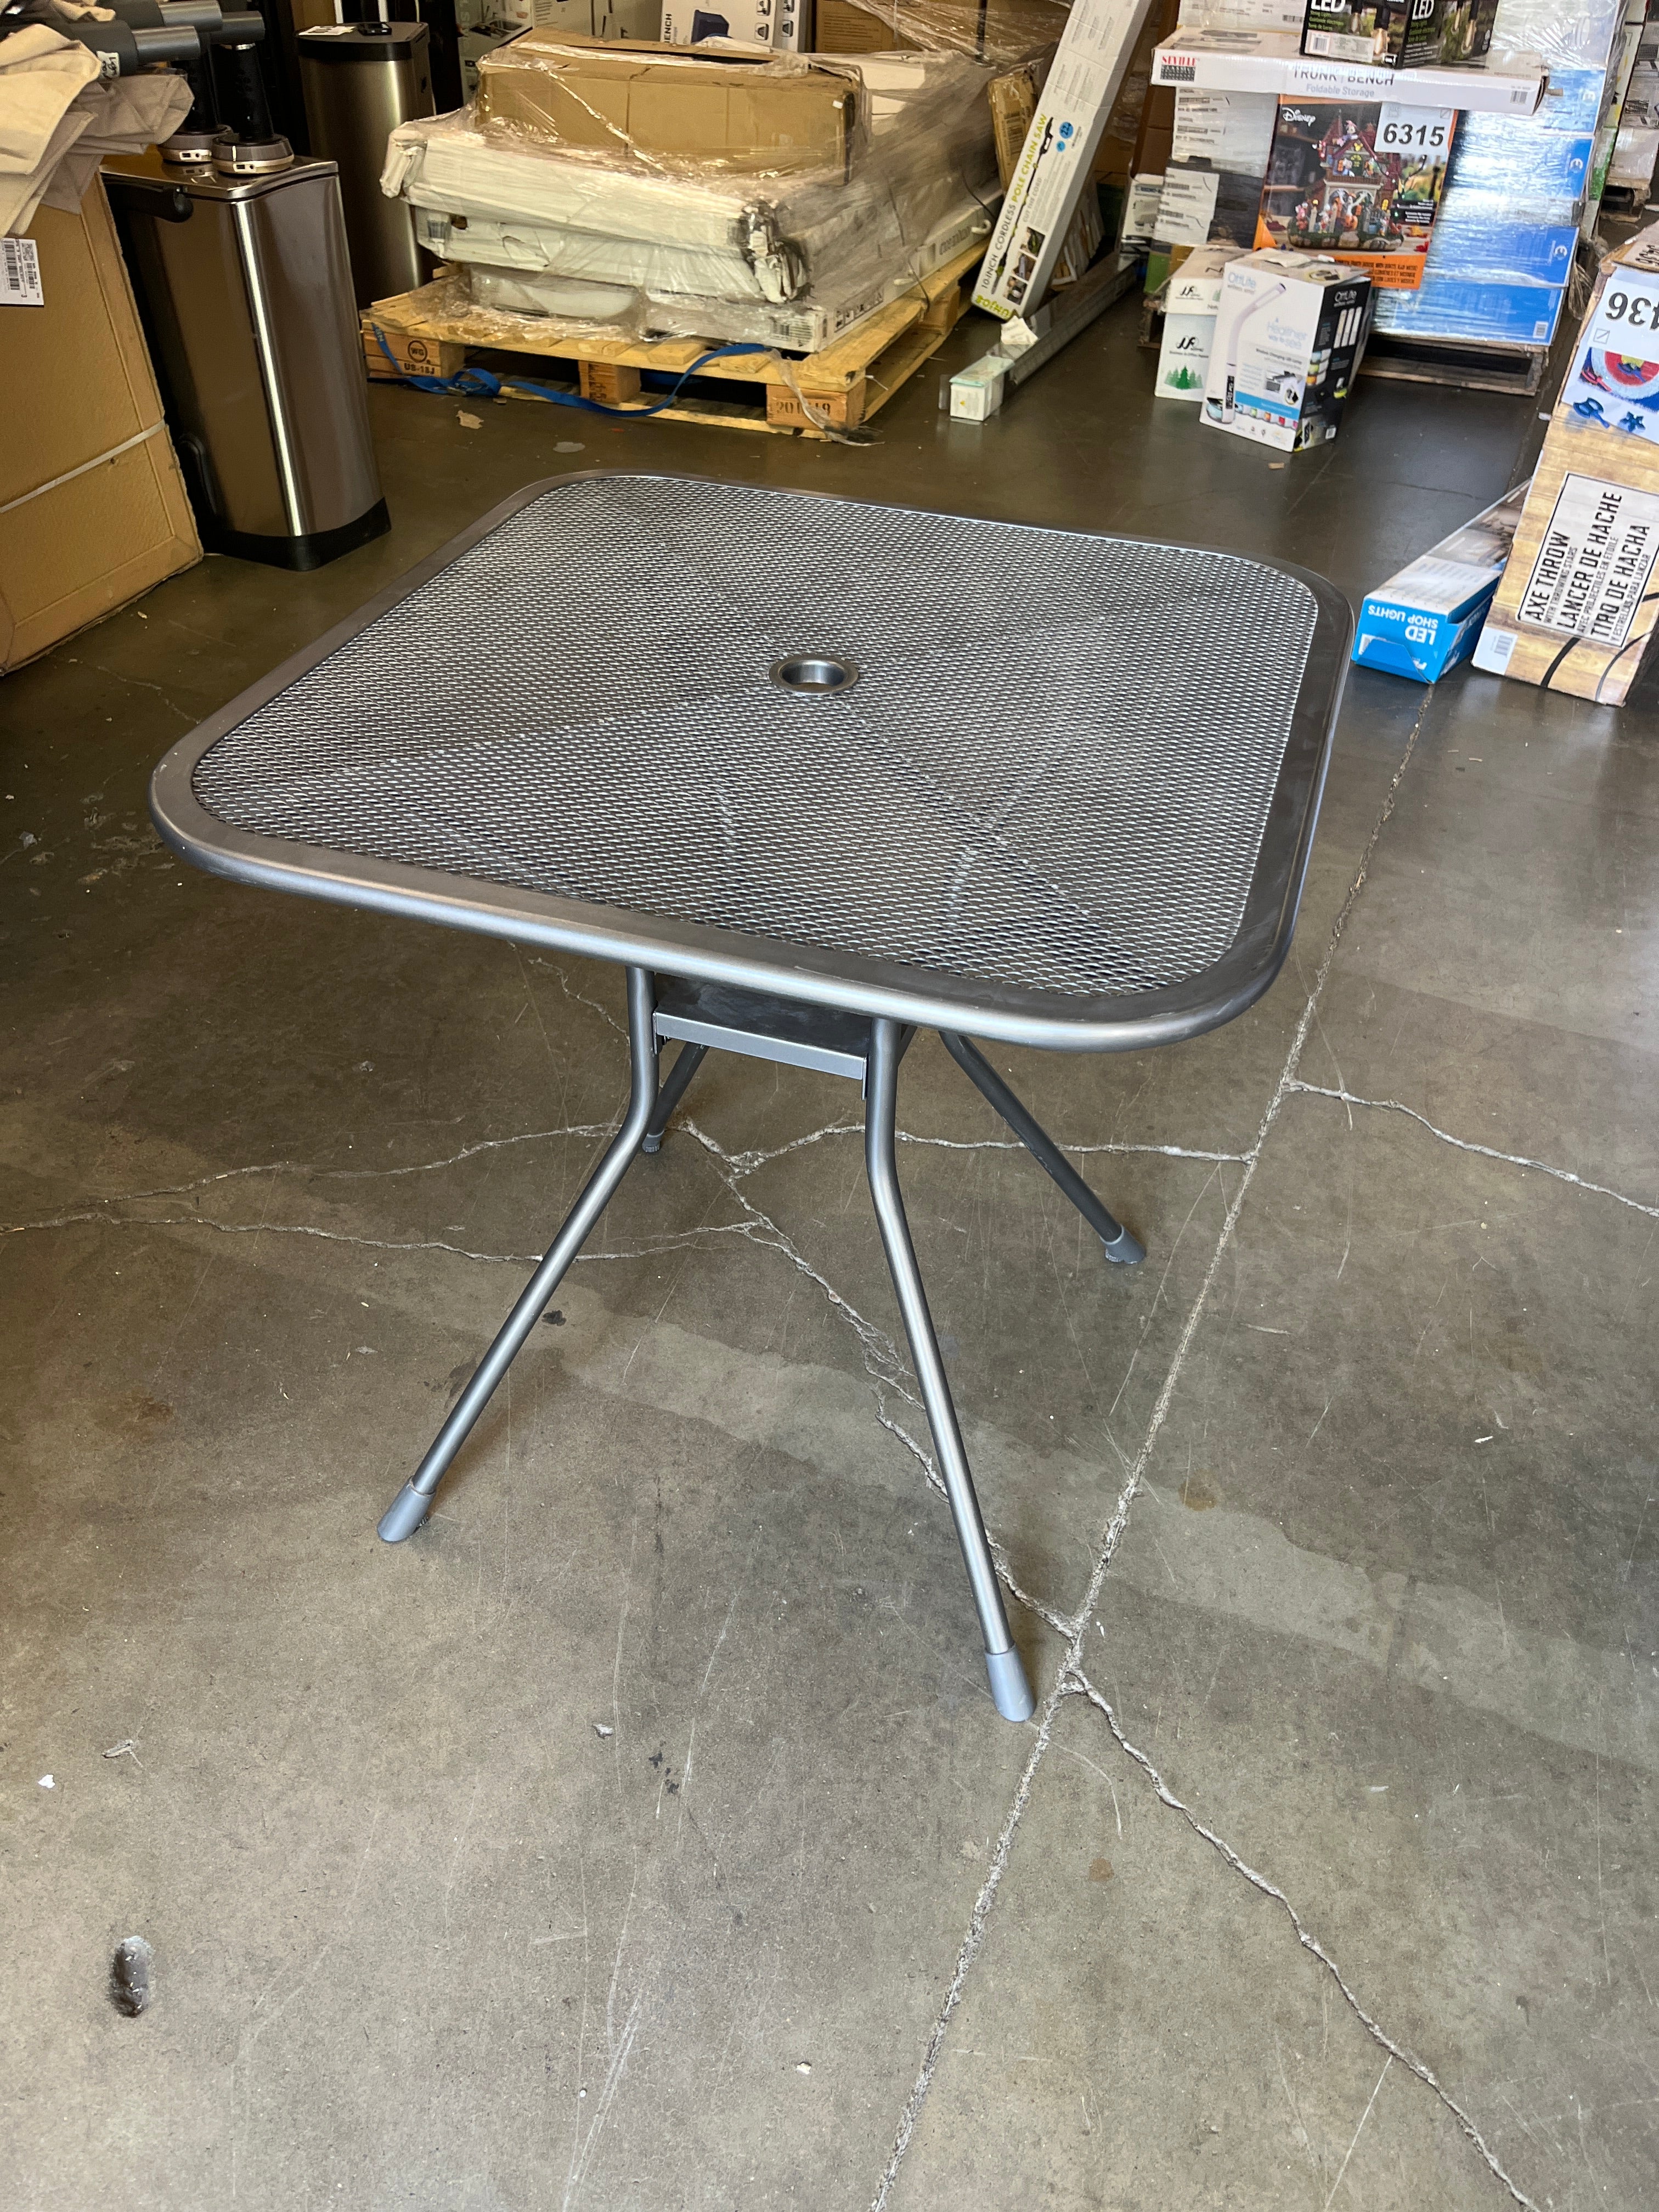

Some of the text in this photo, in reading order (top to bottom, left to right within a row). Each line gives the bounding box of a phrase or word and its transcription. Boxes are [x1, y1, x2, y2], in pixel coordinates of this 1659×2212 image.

[664, 14, 672, 43] ENCH
[1306, 83, 1374, 98] Foldable Storage
[1347, 70, 1395, 86] BENCH
[1384, 123, 1444, 146] 6315
[995, 204, 1016, 250] CORDLESS
[1012, 176, 1026, 203] POLE
[1021, 140, 1038, 174] CHAIN
[1034, 114, 1047, 139] SAW
[1557, 492, 1622, 629] LANCER DE HACHE
[1525, 530, 1570, 621] AXE THROW
[1544, 606, 1556, 624] WITH
[1564, 546, 1578, 569] STARS
[1590, 525, 1650, 636] TIRO DE HACHA
[1368, 605, 1438, 629] SHOP LIGHTS
[1577, 615, 1590, 633] AVEC
[1404, 625, 1436, 645] LED
